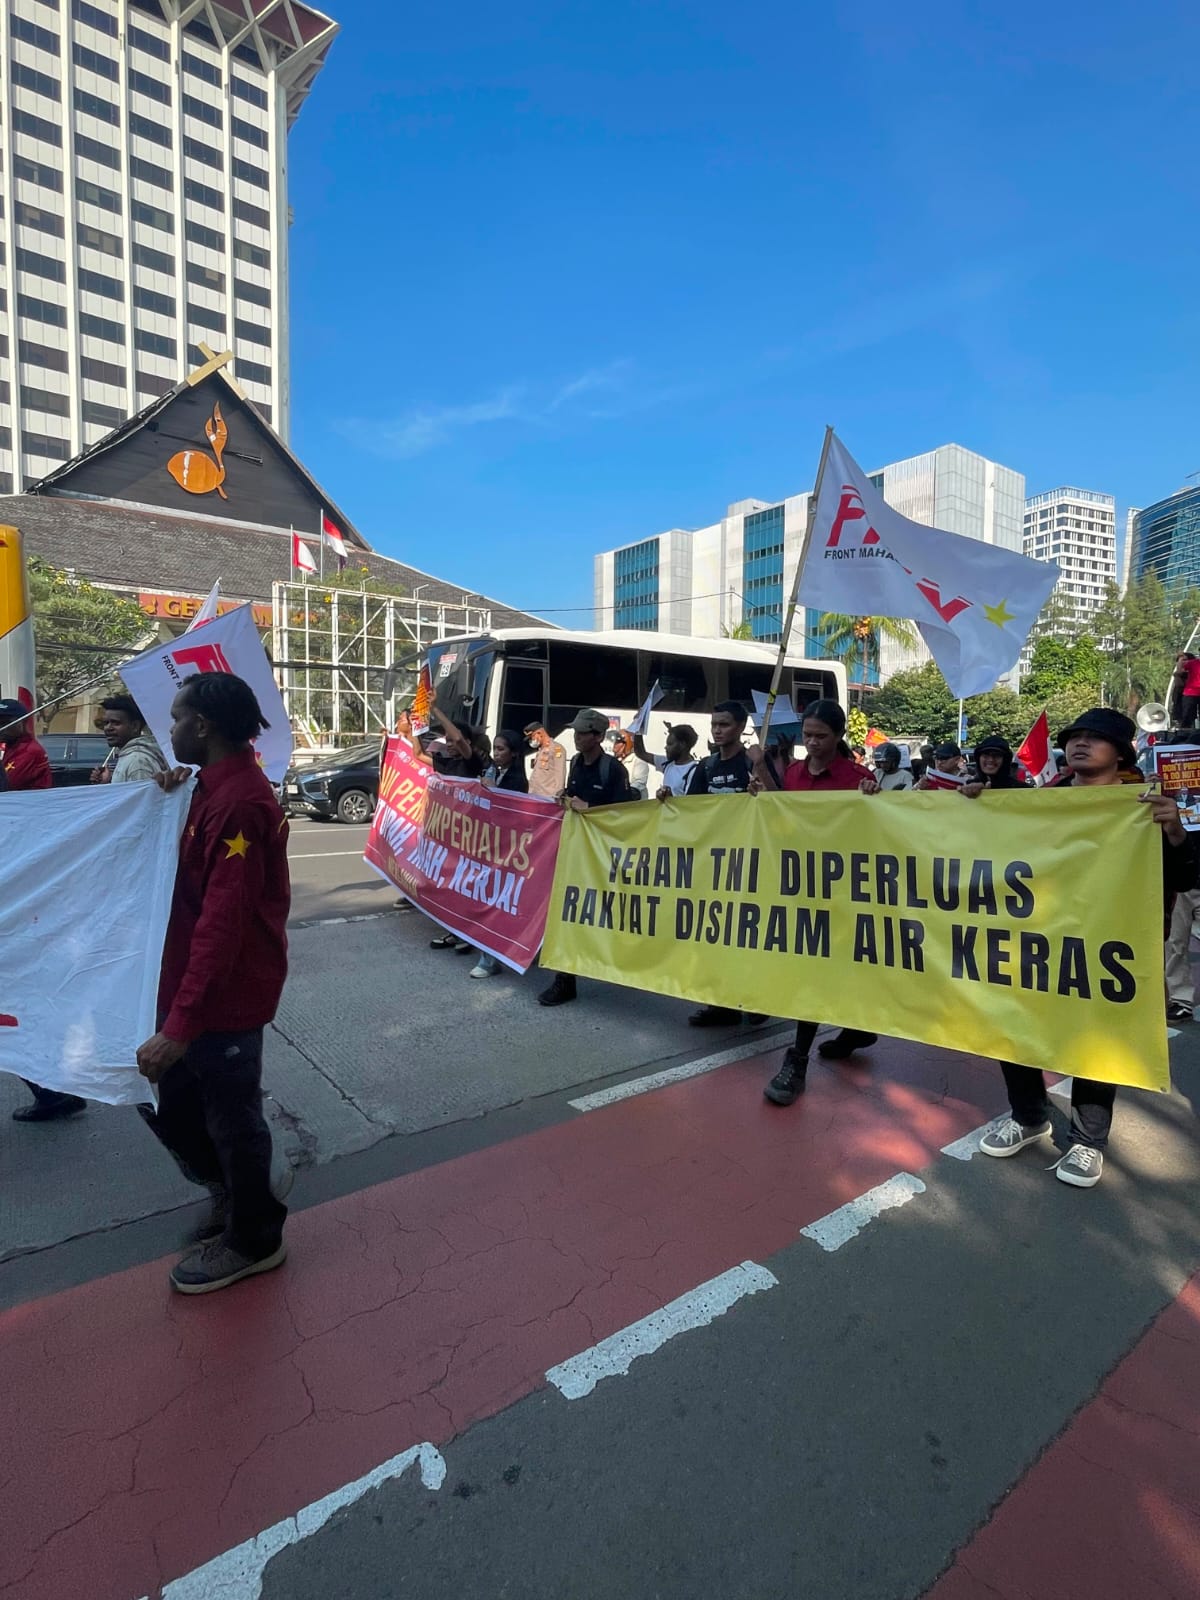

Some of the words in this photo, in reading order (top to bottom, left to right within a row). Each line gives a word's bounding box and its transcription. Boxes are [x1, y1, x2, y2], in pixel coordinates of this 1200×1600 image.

[824, 549, 856, 560] FRONT
[162, 655, 179, 680] FRONT
[449, 857, 525, 916] KERJA!
[609, 847, 694, 889] PERAN
[711, 848, 760, 894] TNI
[780, 850, 1035, 918] DIPERLUAS
[562, 886, 661, 937] RAKYAT
[676, 898, 831, 958] DISIRAM
[853, 913, 925, 973] AIR
[951, 924, 1137, 1004] KERAS
